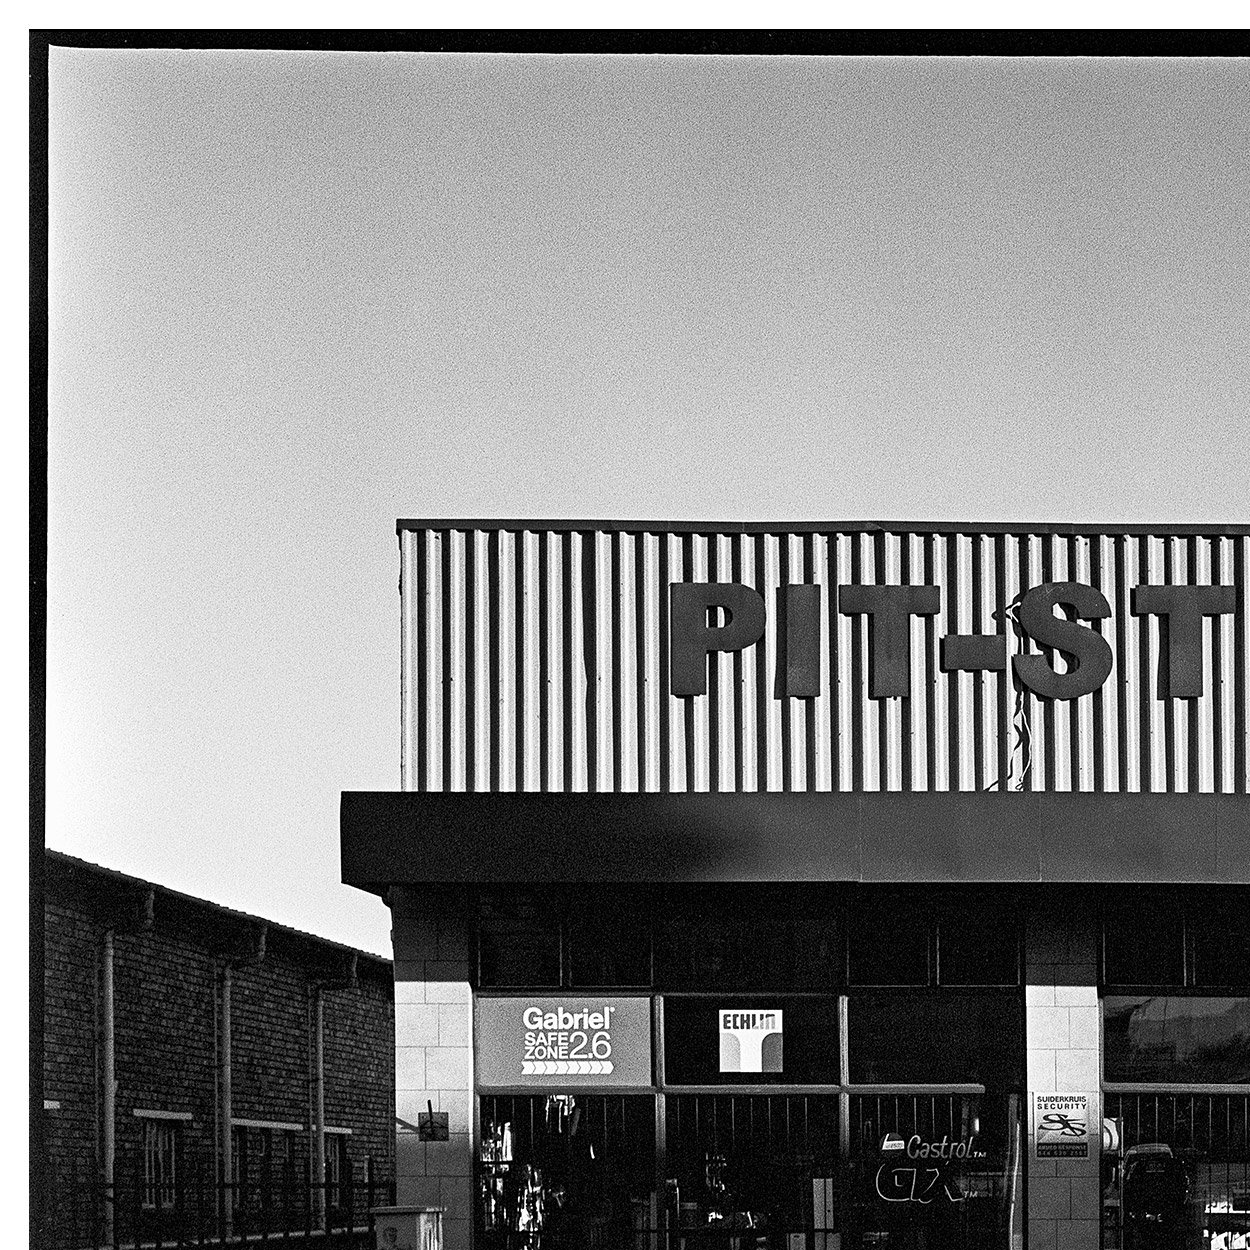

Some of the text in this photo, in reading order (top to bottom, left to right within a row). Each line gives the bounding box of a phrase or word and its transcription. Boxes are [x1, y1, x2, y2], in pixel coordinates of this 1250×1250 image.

[522, 1006, 611, 1030] Gabriel
[524, 1030, 612, 1060] SAFE 2.6
[524, 1045, 569, 1060] ZONE
[1037, 1095, 1087, 1103] SUIDERKRUIS
[907, 1134, 973, 1159] Castrol
